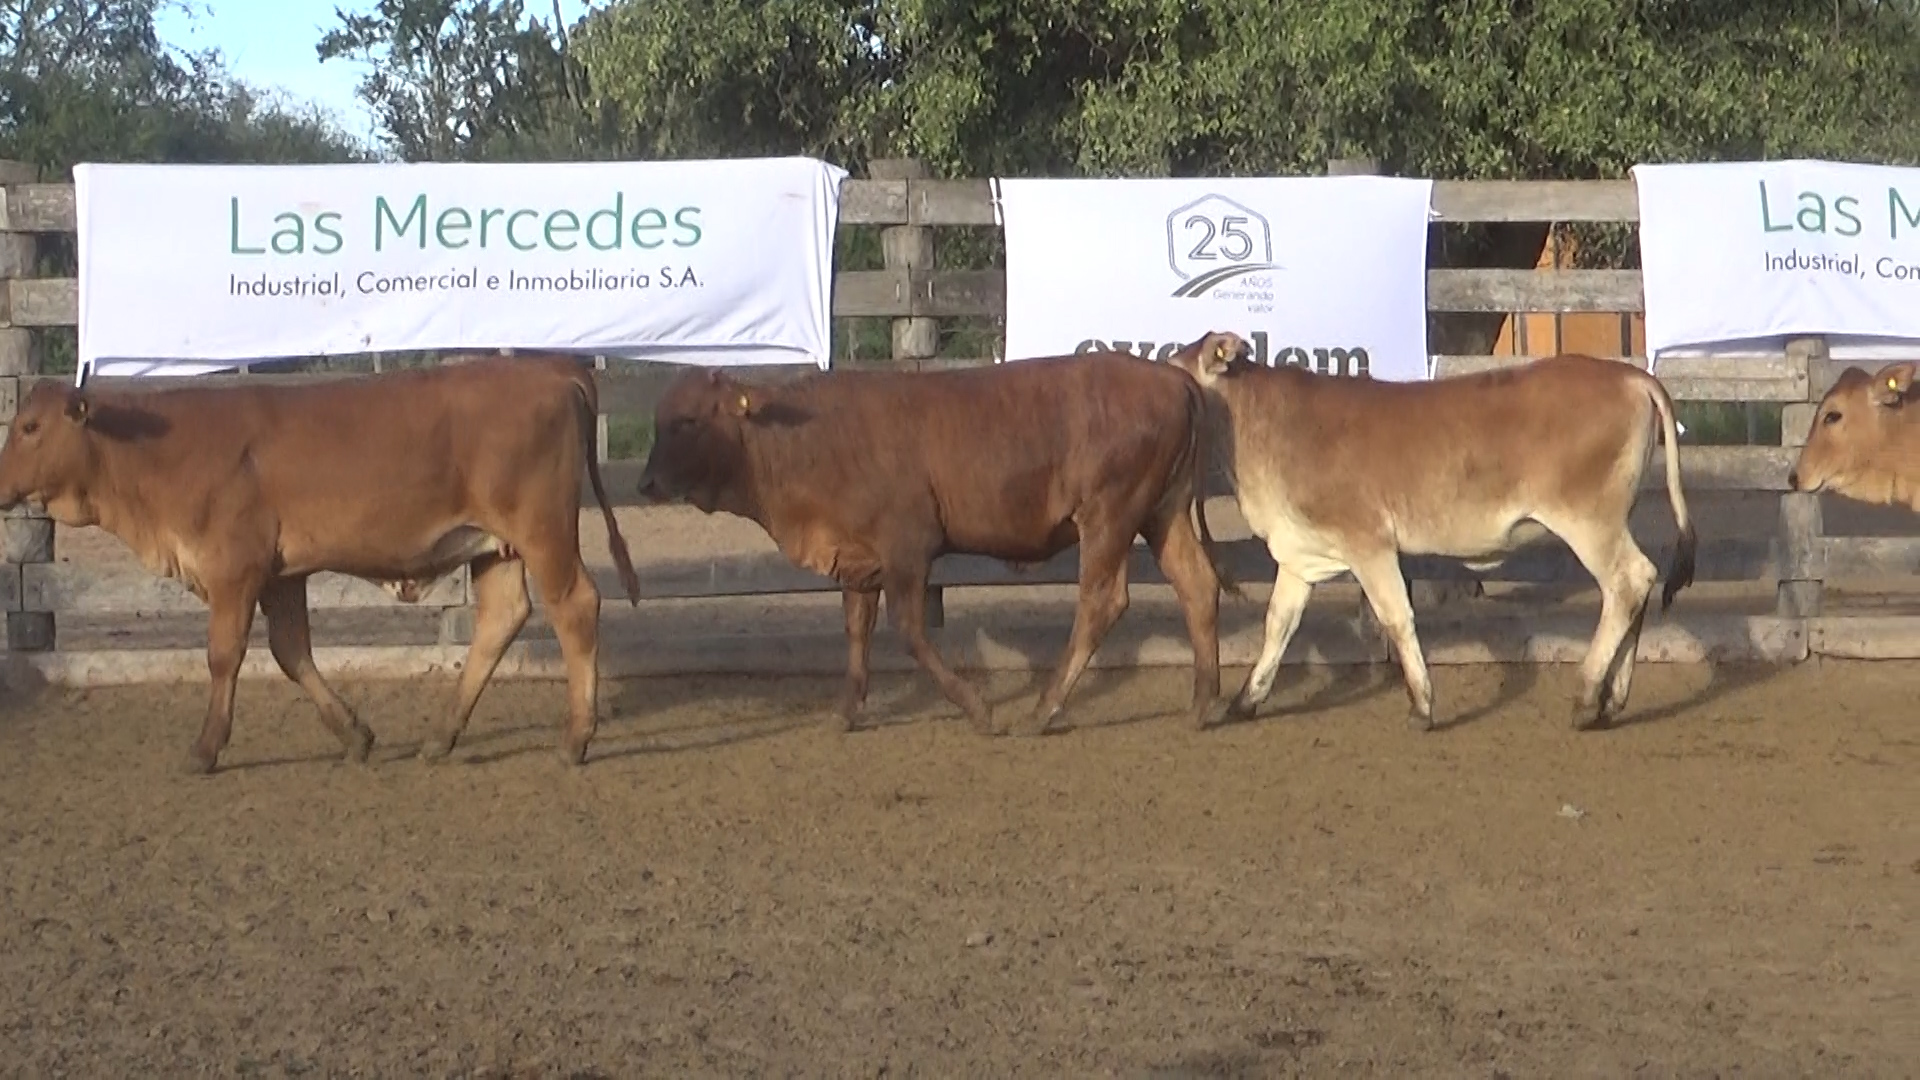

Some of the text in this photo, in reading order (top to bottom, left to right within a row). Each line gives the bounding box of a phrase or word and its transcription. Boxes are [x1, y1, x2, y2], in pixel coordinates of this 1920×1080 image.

[230, 191, 702, 255] Las Mercedes
[1758, 180, 1862, 237] Las
[1184, 215, 1253, 261] 25
[230, 265, 704, 299] Industrial, Comercial e Inmobiliaria S.A.
[1765, 248, 1865, 280] Industrial,
